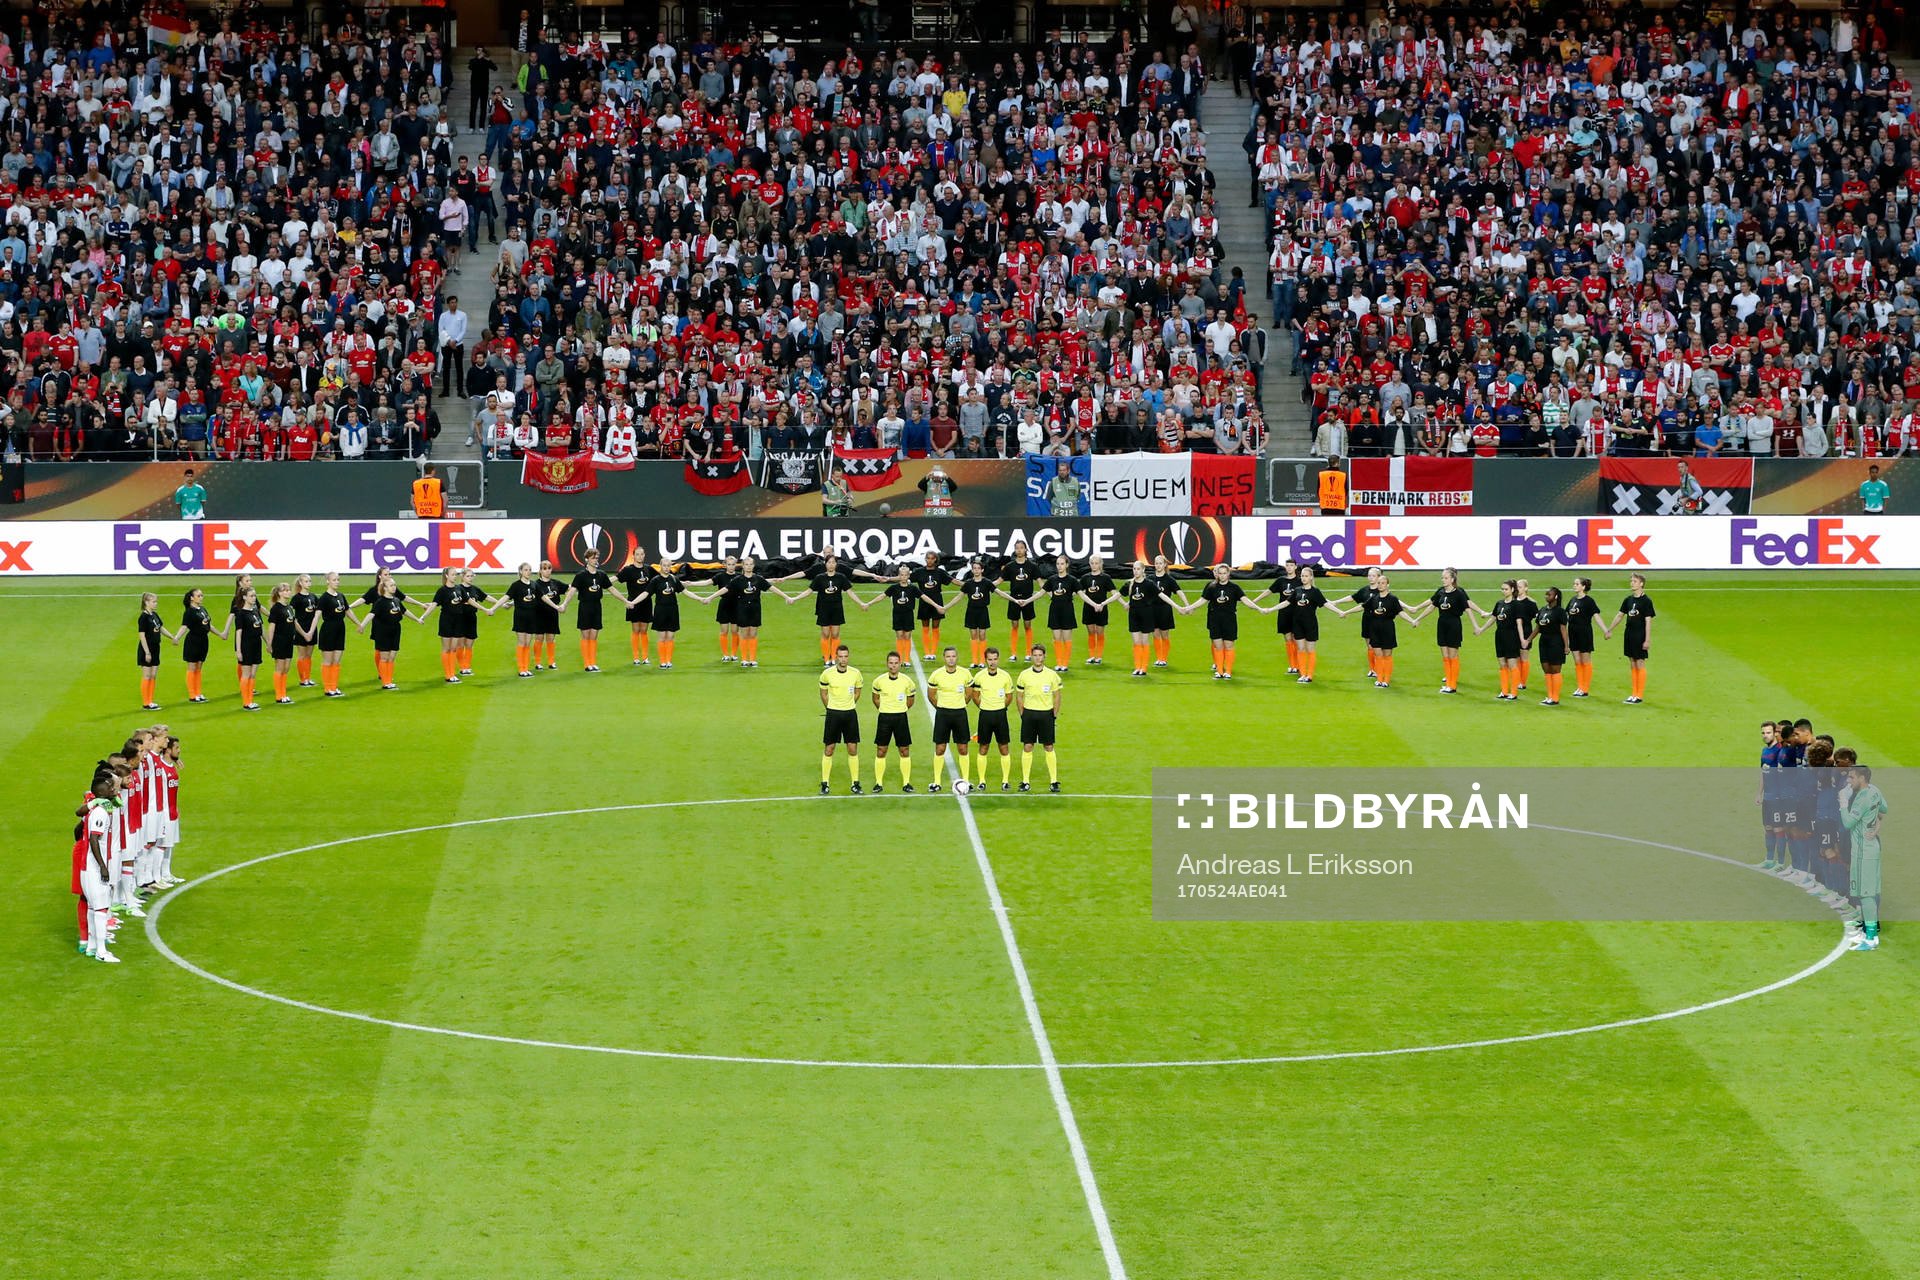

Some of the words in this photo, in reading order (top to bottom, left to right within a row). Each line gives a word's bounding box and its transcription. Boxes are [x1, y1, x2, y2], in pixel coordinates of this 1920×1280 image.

[1027, 474, 1252, 502] SREGUEMINES
[1362, 491, 1424, 505] DENMARK
[1429, 492, 1460, 505] REDS
[114, 524, 268, 571] FedEx
[349, 523, 504, 570] FedEx
[658, 529, 768, 560] UEFA
[780, 528, 942, 560] EUROPA
[954, 528, 1114, 559] LEAGUE
[1266, 519, 1419, 566] FedEx
[1500, 518, 1651, 566] FedEx
[1730, 518, 1881, 565] FedEx
[1785, 812, 1796, 822] 25
[1821, 834, 1831, 844] 21
